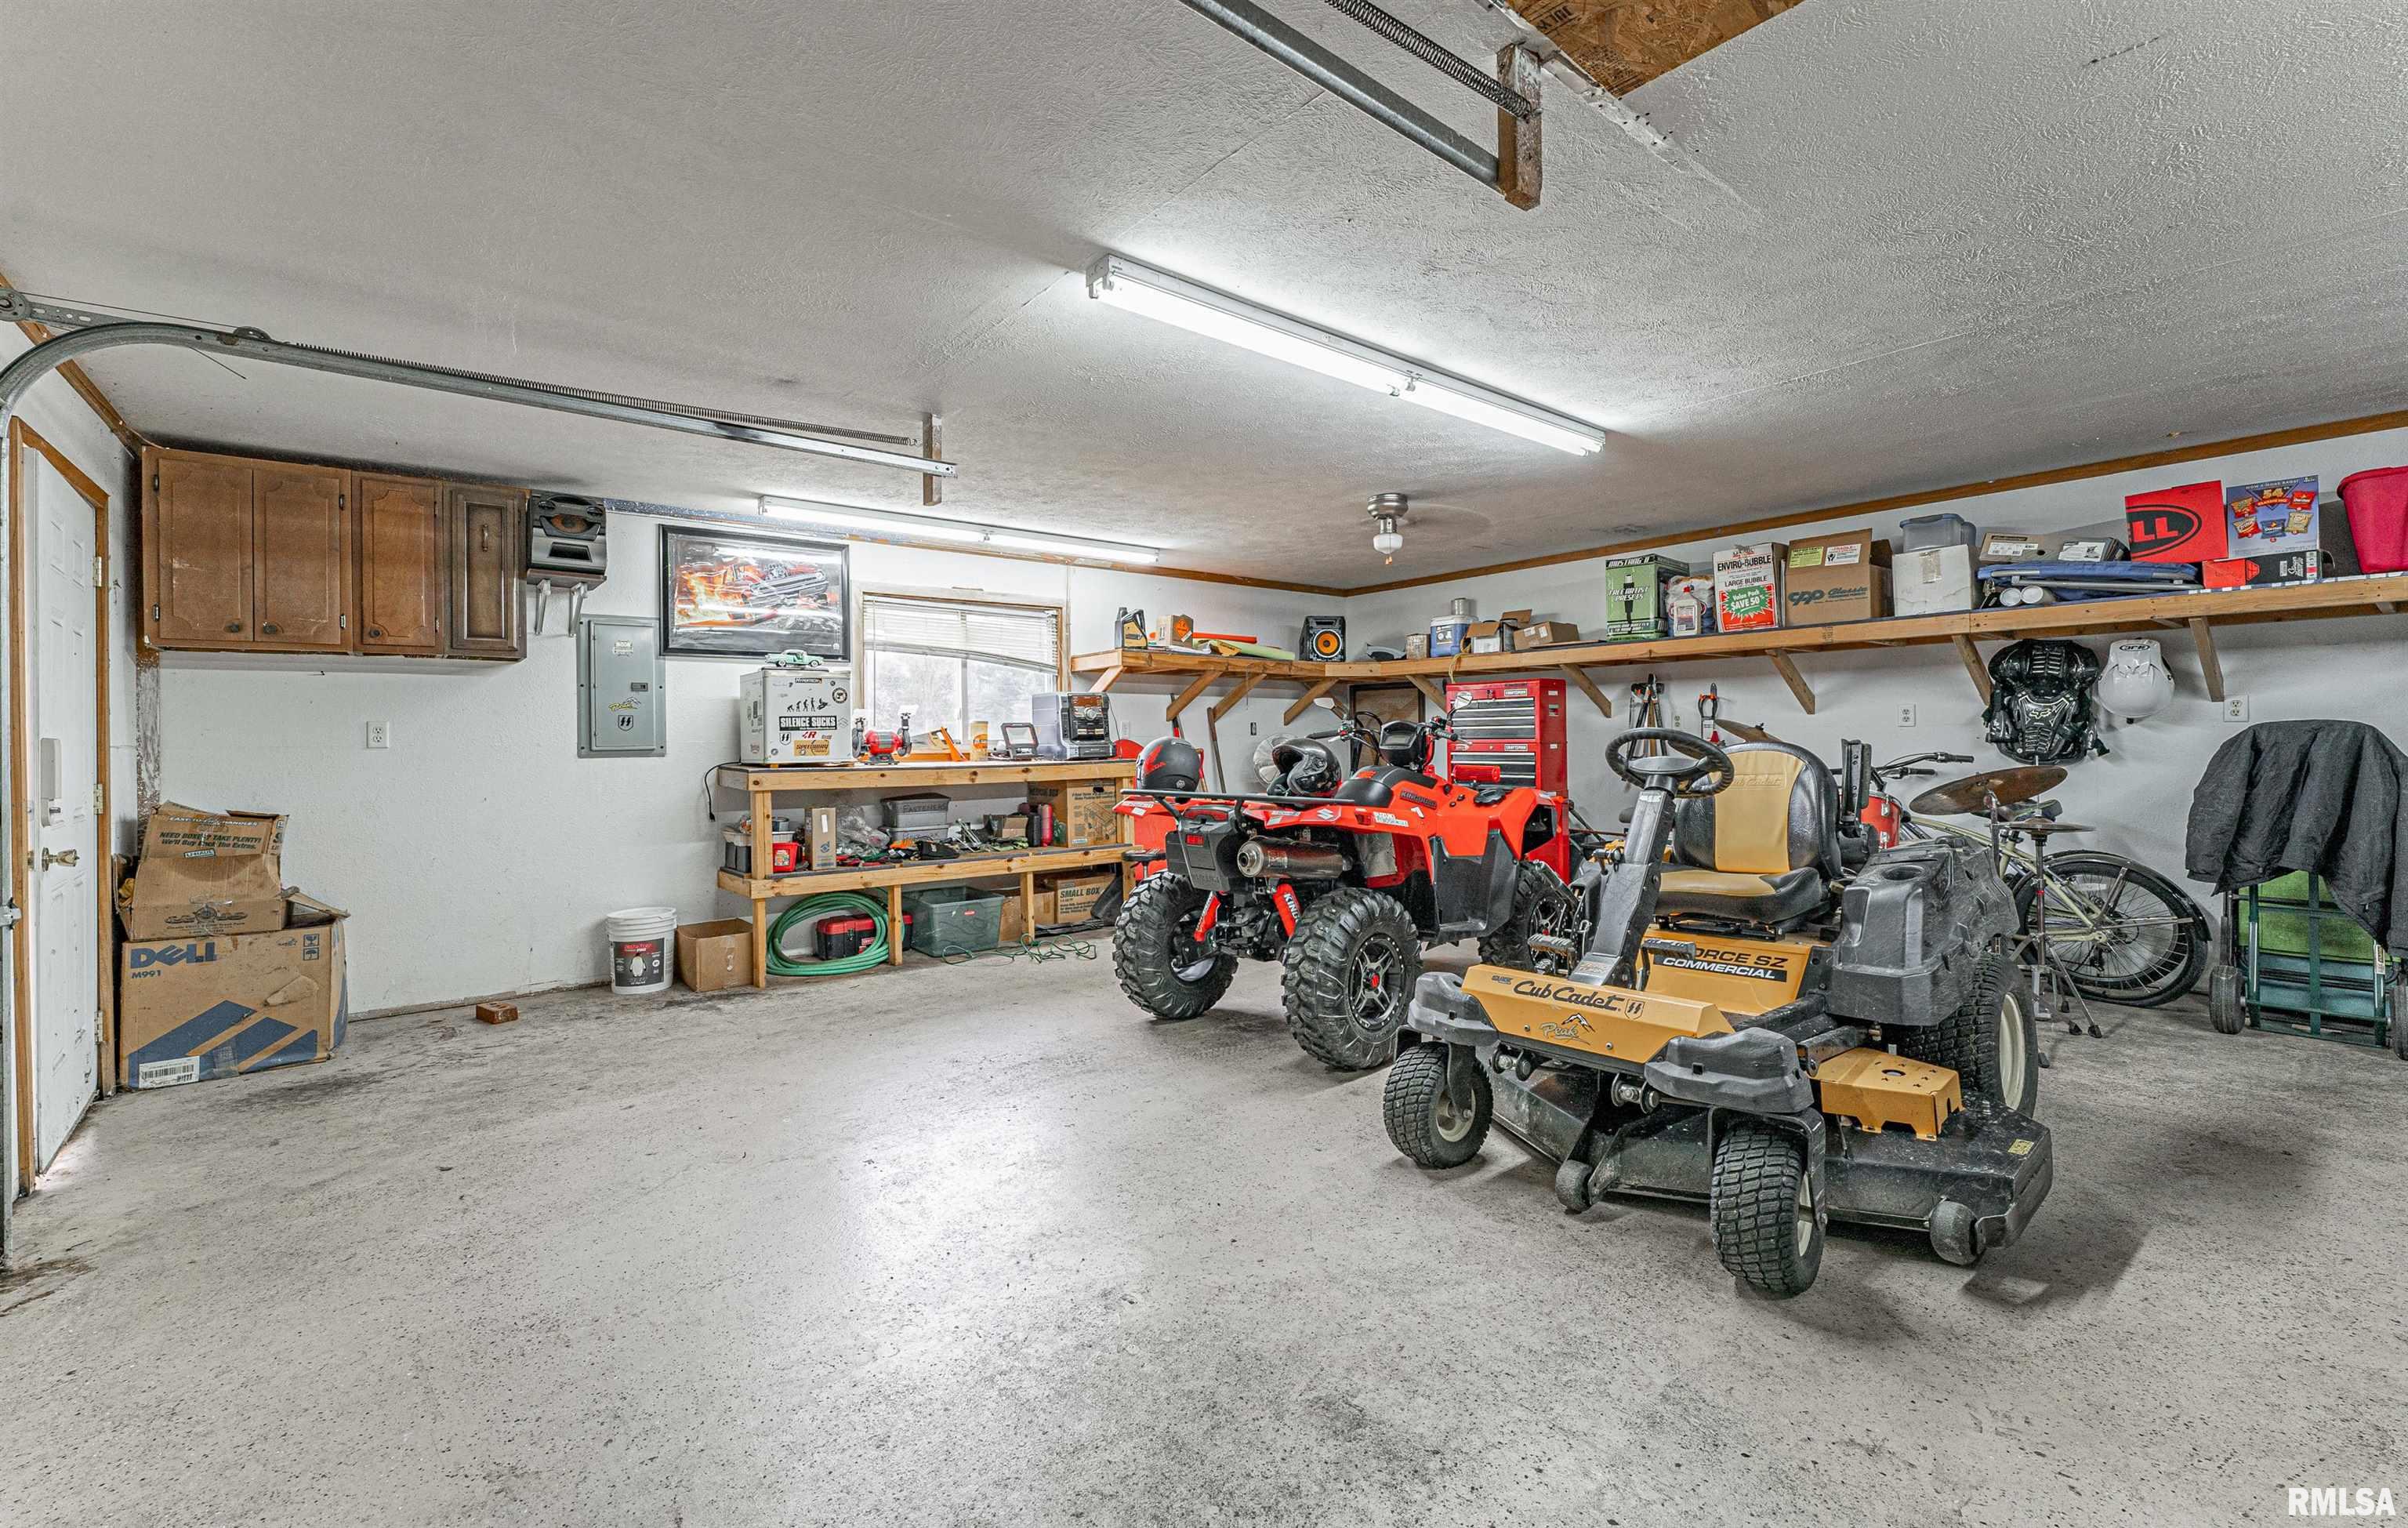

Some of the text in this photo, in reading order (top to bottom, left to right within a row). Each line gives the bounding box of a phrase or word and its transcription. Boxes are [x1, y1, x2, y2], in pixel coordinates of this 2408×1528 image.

[2131, 517, 2179, 543] LL
[1717, 555, 1772, 572] ENVIRO-BUBBLE
[1724, 575, 1768, 587] LARGE BUBBLE
[1731, 599, 1750, 611] SAVE
[780, 717, 836, 728] SILENCE SUCKS
[1060, 887, 1101, 898] SMALL BOX
[130, 942, 217, 968] DELL
[1695, 948, 1789, 968] ORCE SZ
[131, 970, 162, 979] M991
[1663, 957, 1775, 979] COMMERCIAL
[1513, 980, 1553, 999] Cub
[1539, 1022, 1579, 1040] Peak
